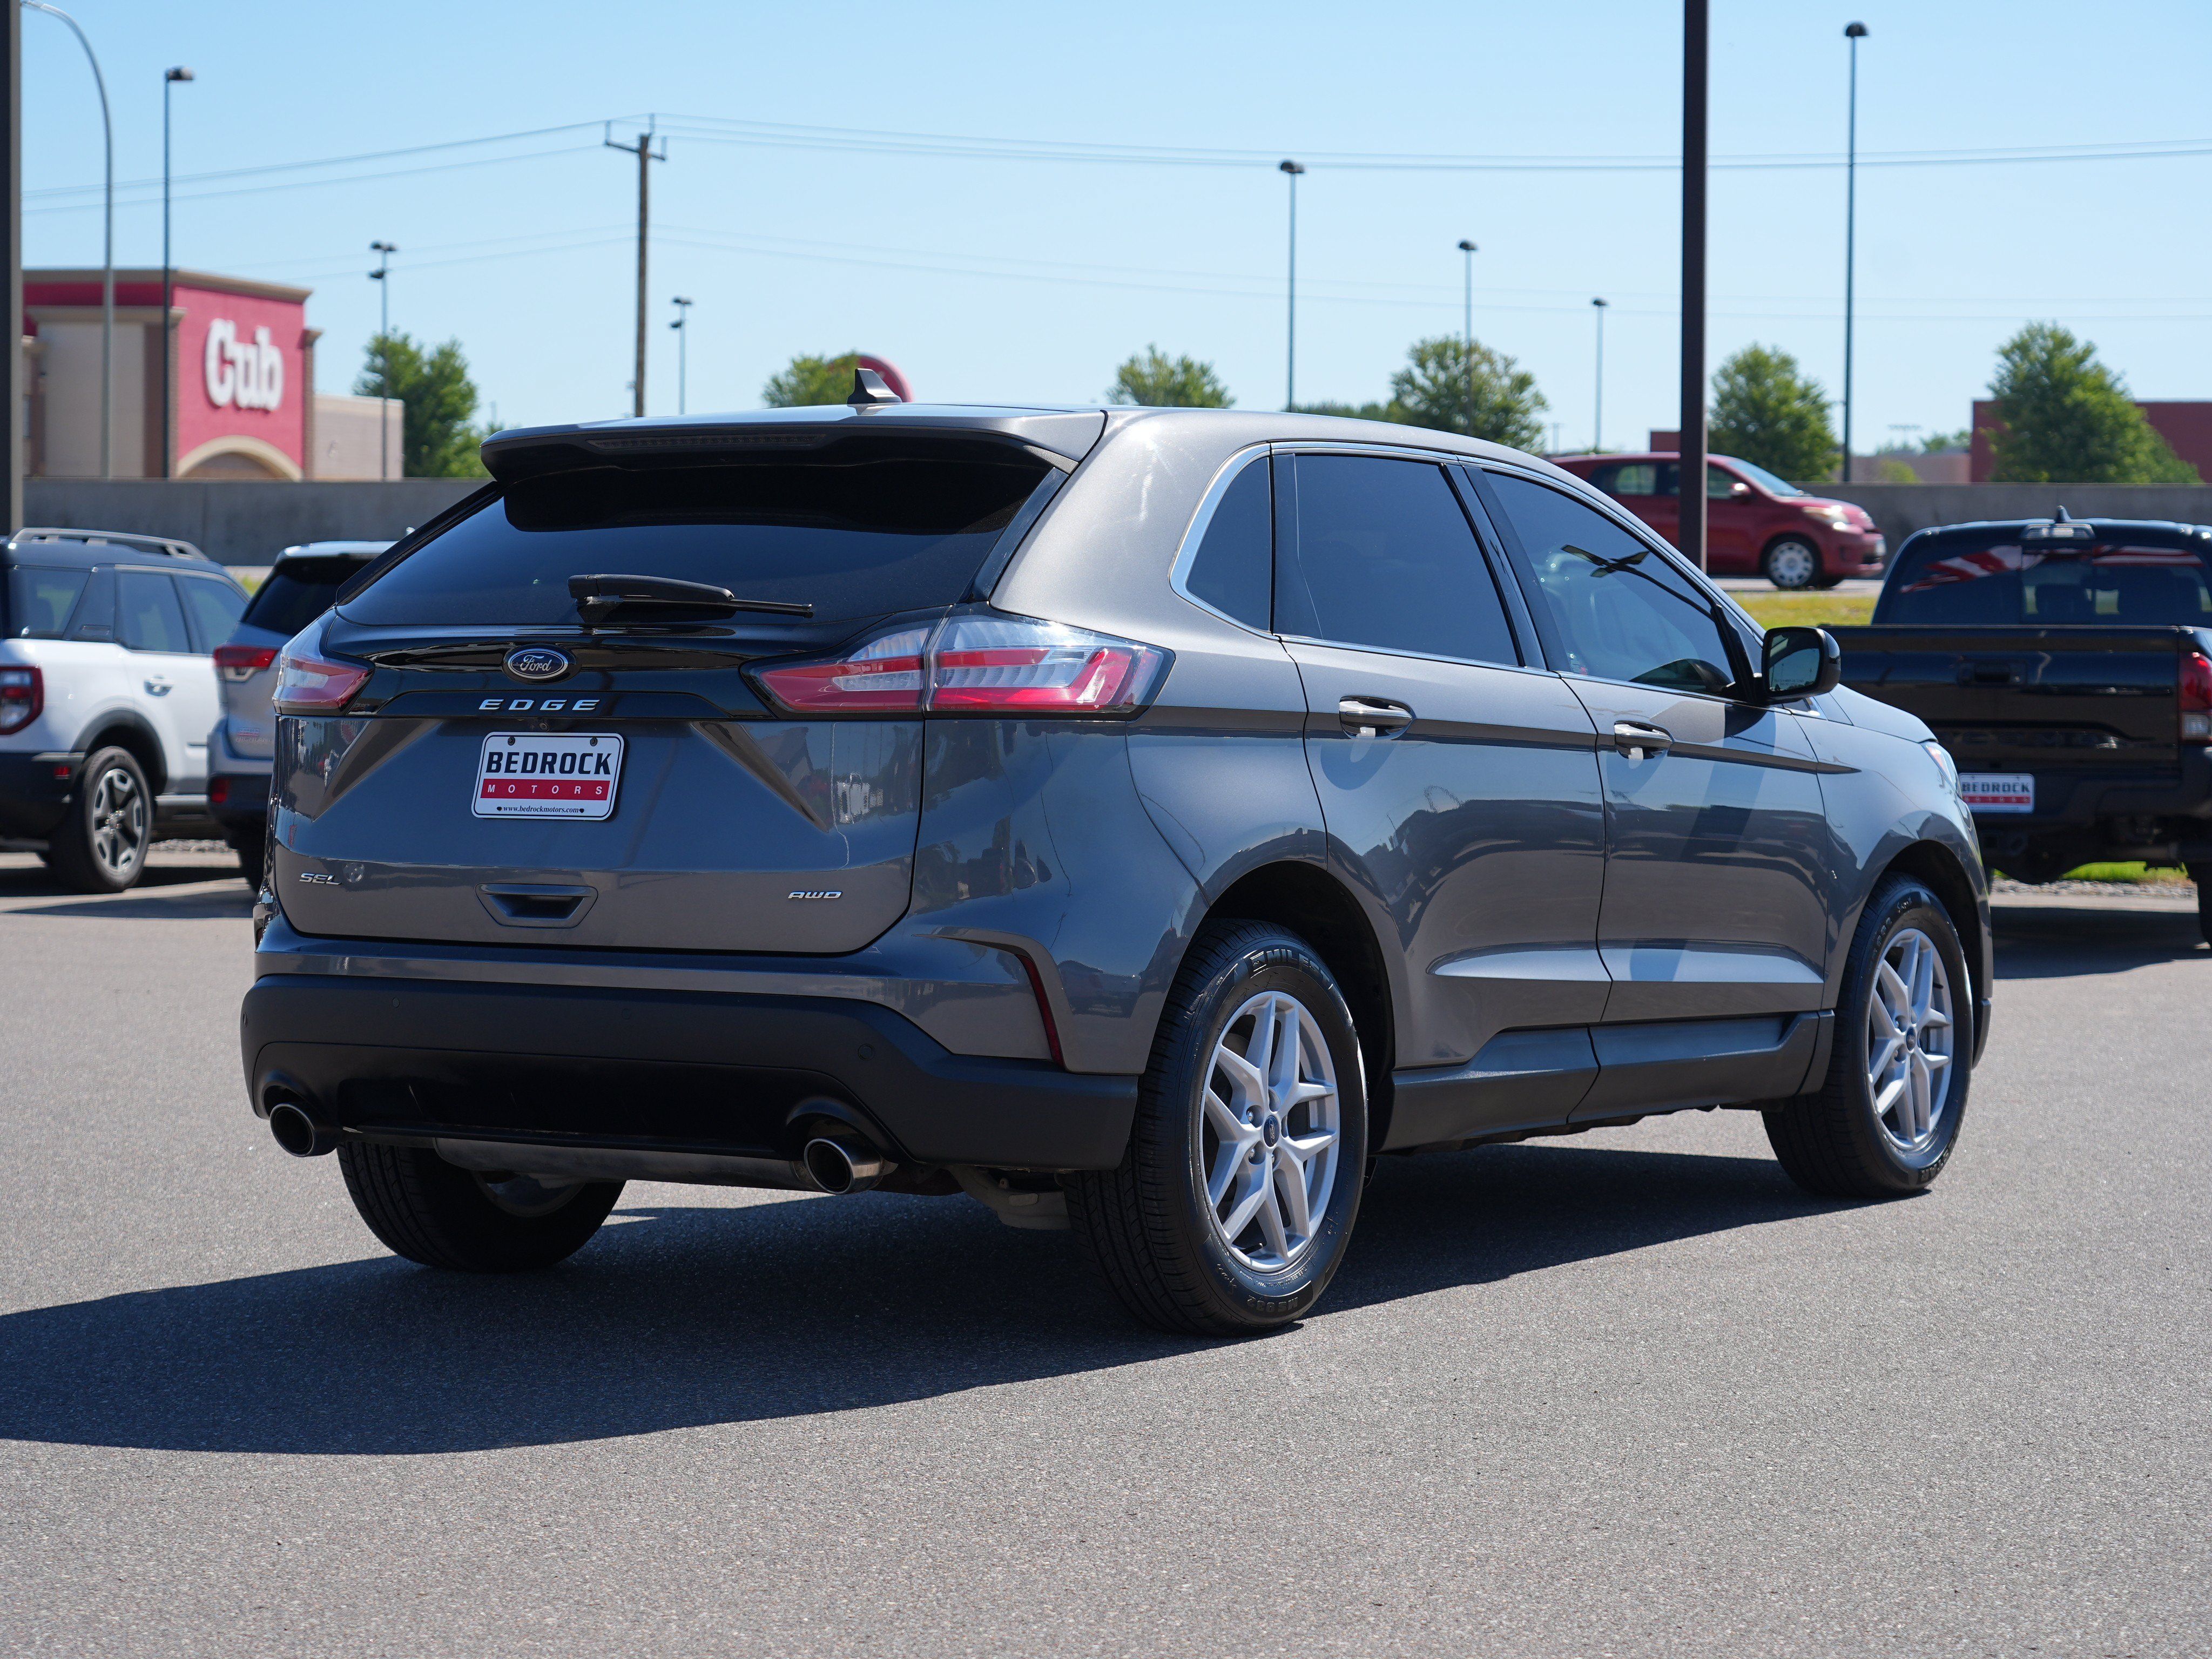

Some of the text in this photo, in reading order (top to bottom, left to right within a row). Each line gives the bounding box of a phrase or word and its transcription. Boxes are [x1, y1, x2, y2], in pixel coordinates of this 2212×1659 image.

[205, 318, 284, 412] Cub
[520, 655, 552, 671] Ford
[478, 699, 601, 711] EDGE
[485, 752, 612, 775] BEDROCK
[487, 784, 603, 795] MOTORS
[1962, 781, 2030, 793] BEDROCK
[299, 873, 341, 885] SEL
